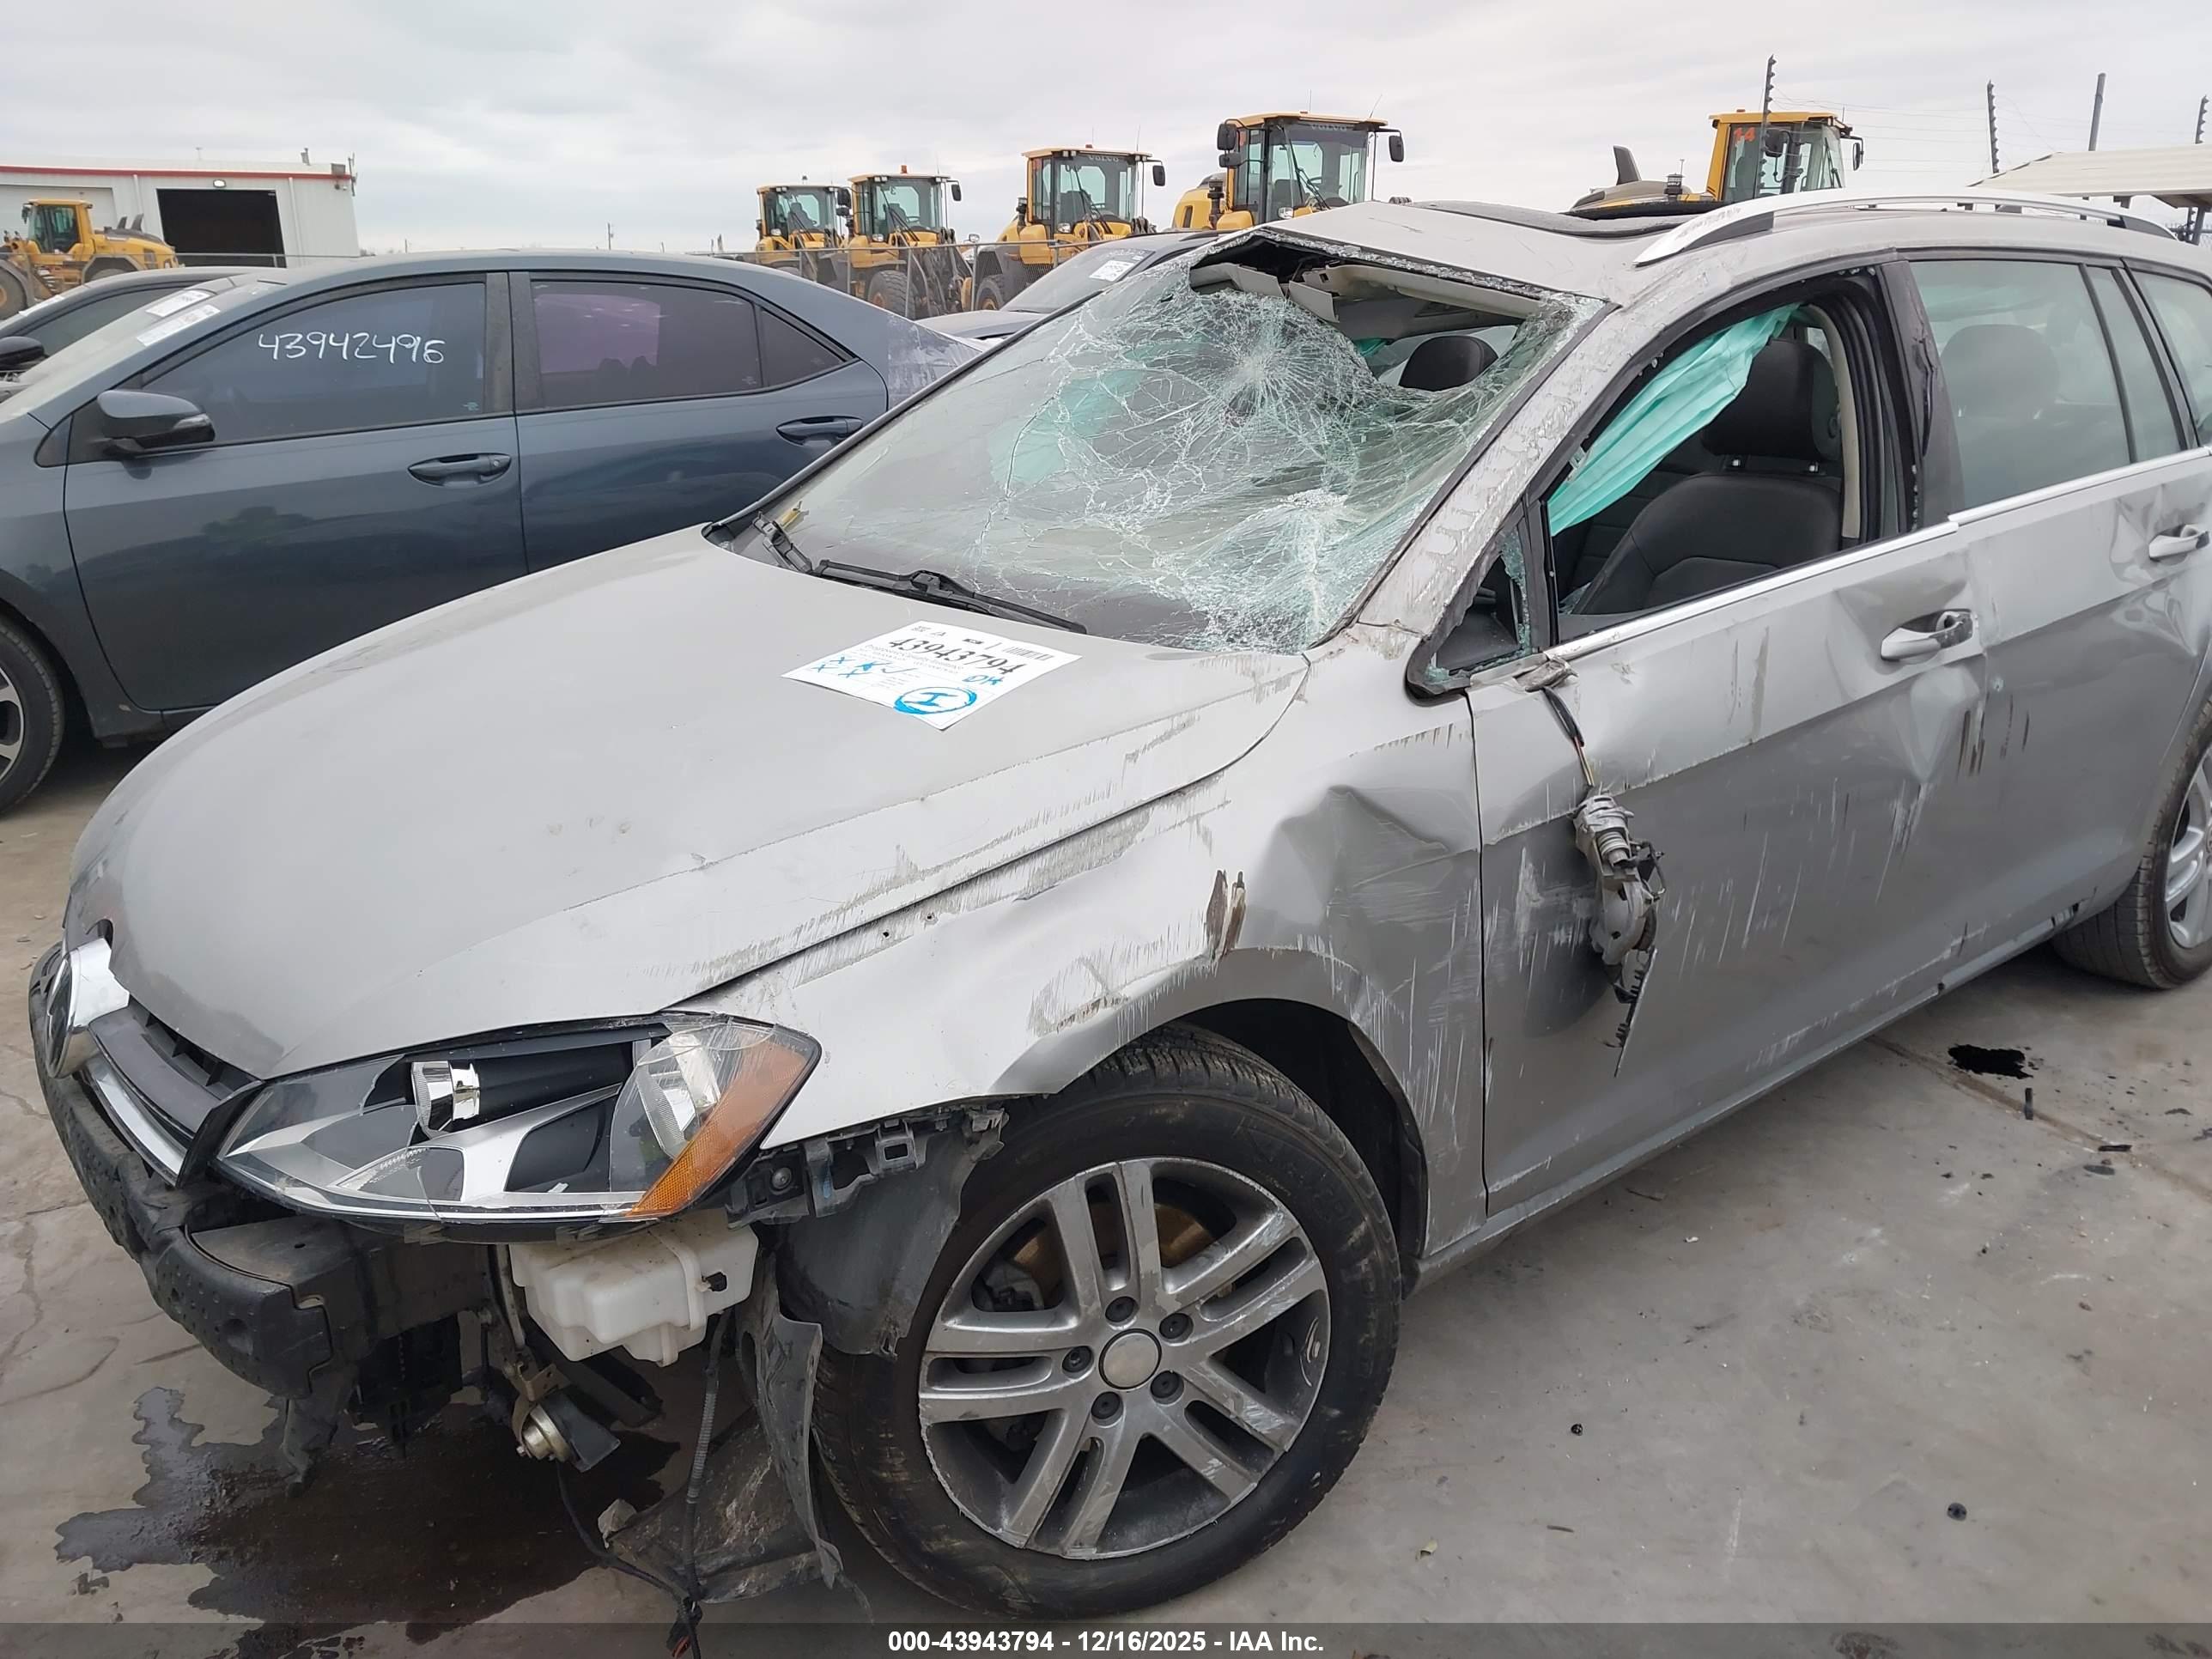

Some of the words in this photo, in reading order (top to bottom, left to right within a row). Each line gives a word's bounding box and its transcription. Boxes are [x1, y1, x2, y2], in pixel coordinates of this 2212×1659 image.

[1733, 126, 1756, 142] 14
[258, 331, 446, 364] 43942496
[889, 638, 1027, 675] 43943794
